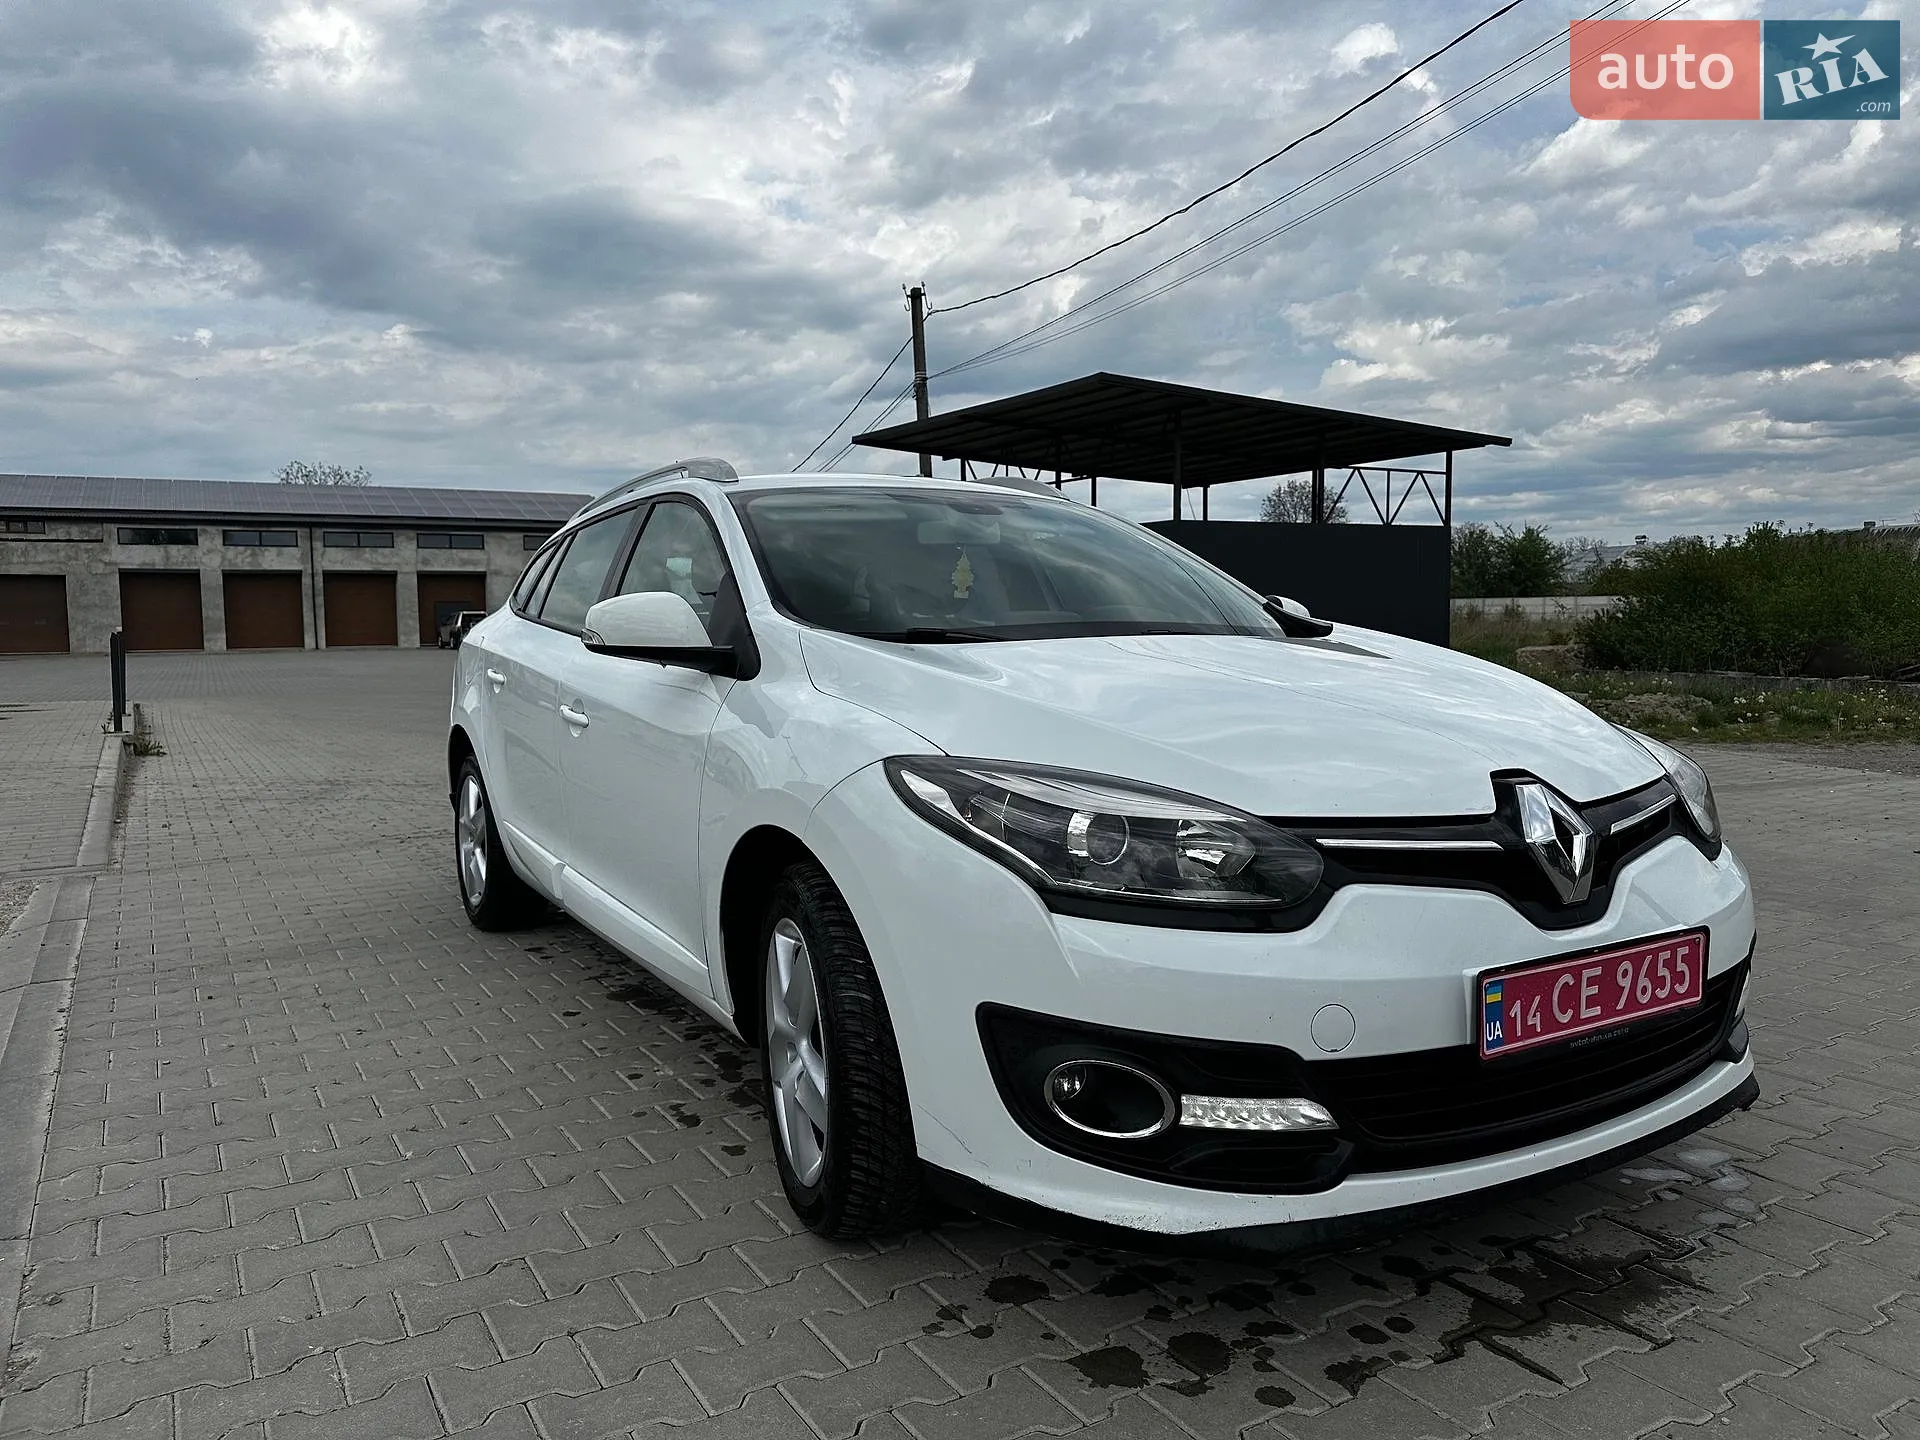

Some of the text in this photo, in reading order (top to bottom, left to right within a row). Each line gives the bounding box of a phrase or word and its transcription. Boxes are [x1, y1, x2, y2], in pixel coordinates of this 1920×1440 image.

[1509, 946, 1691, 1037] 14 CE 9655
[1486, 1020, 1502, 1042] UA
